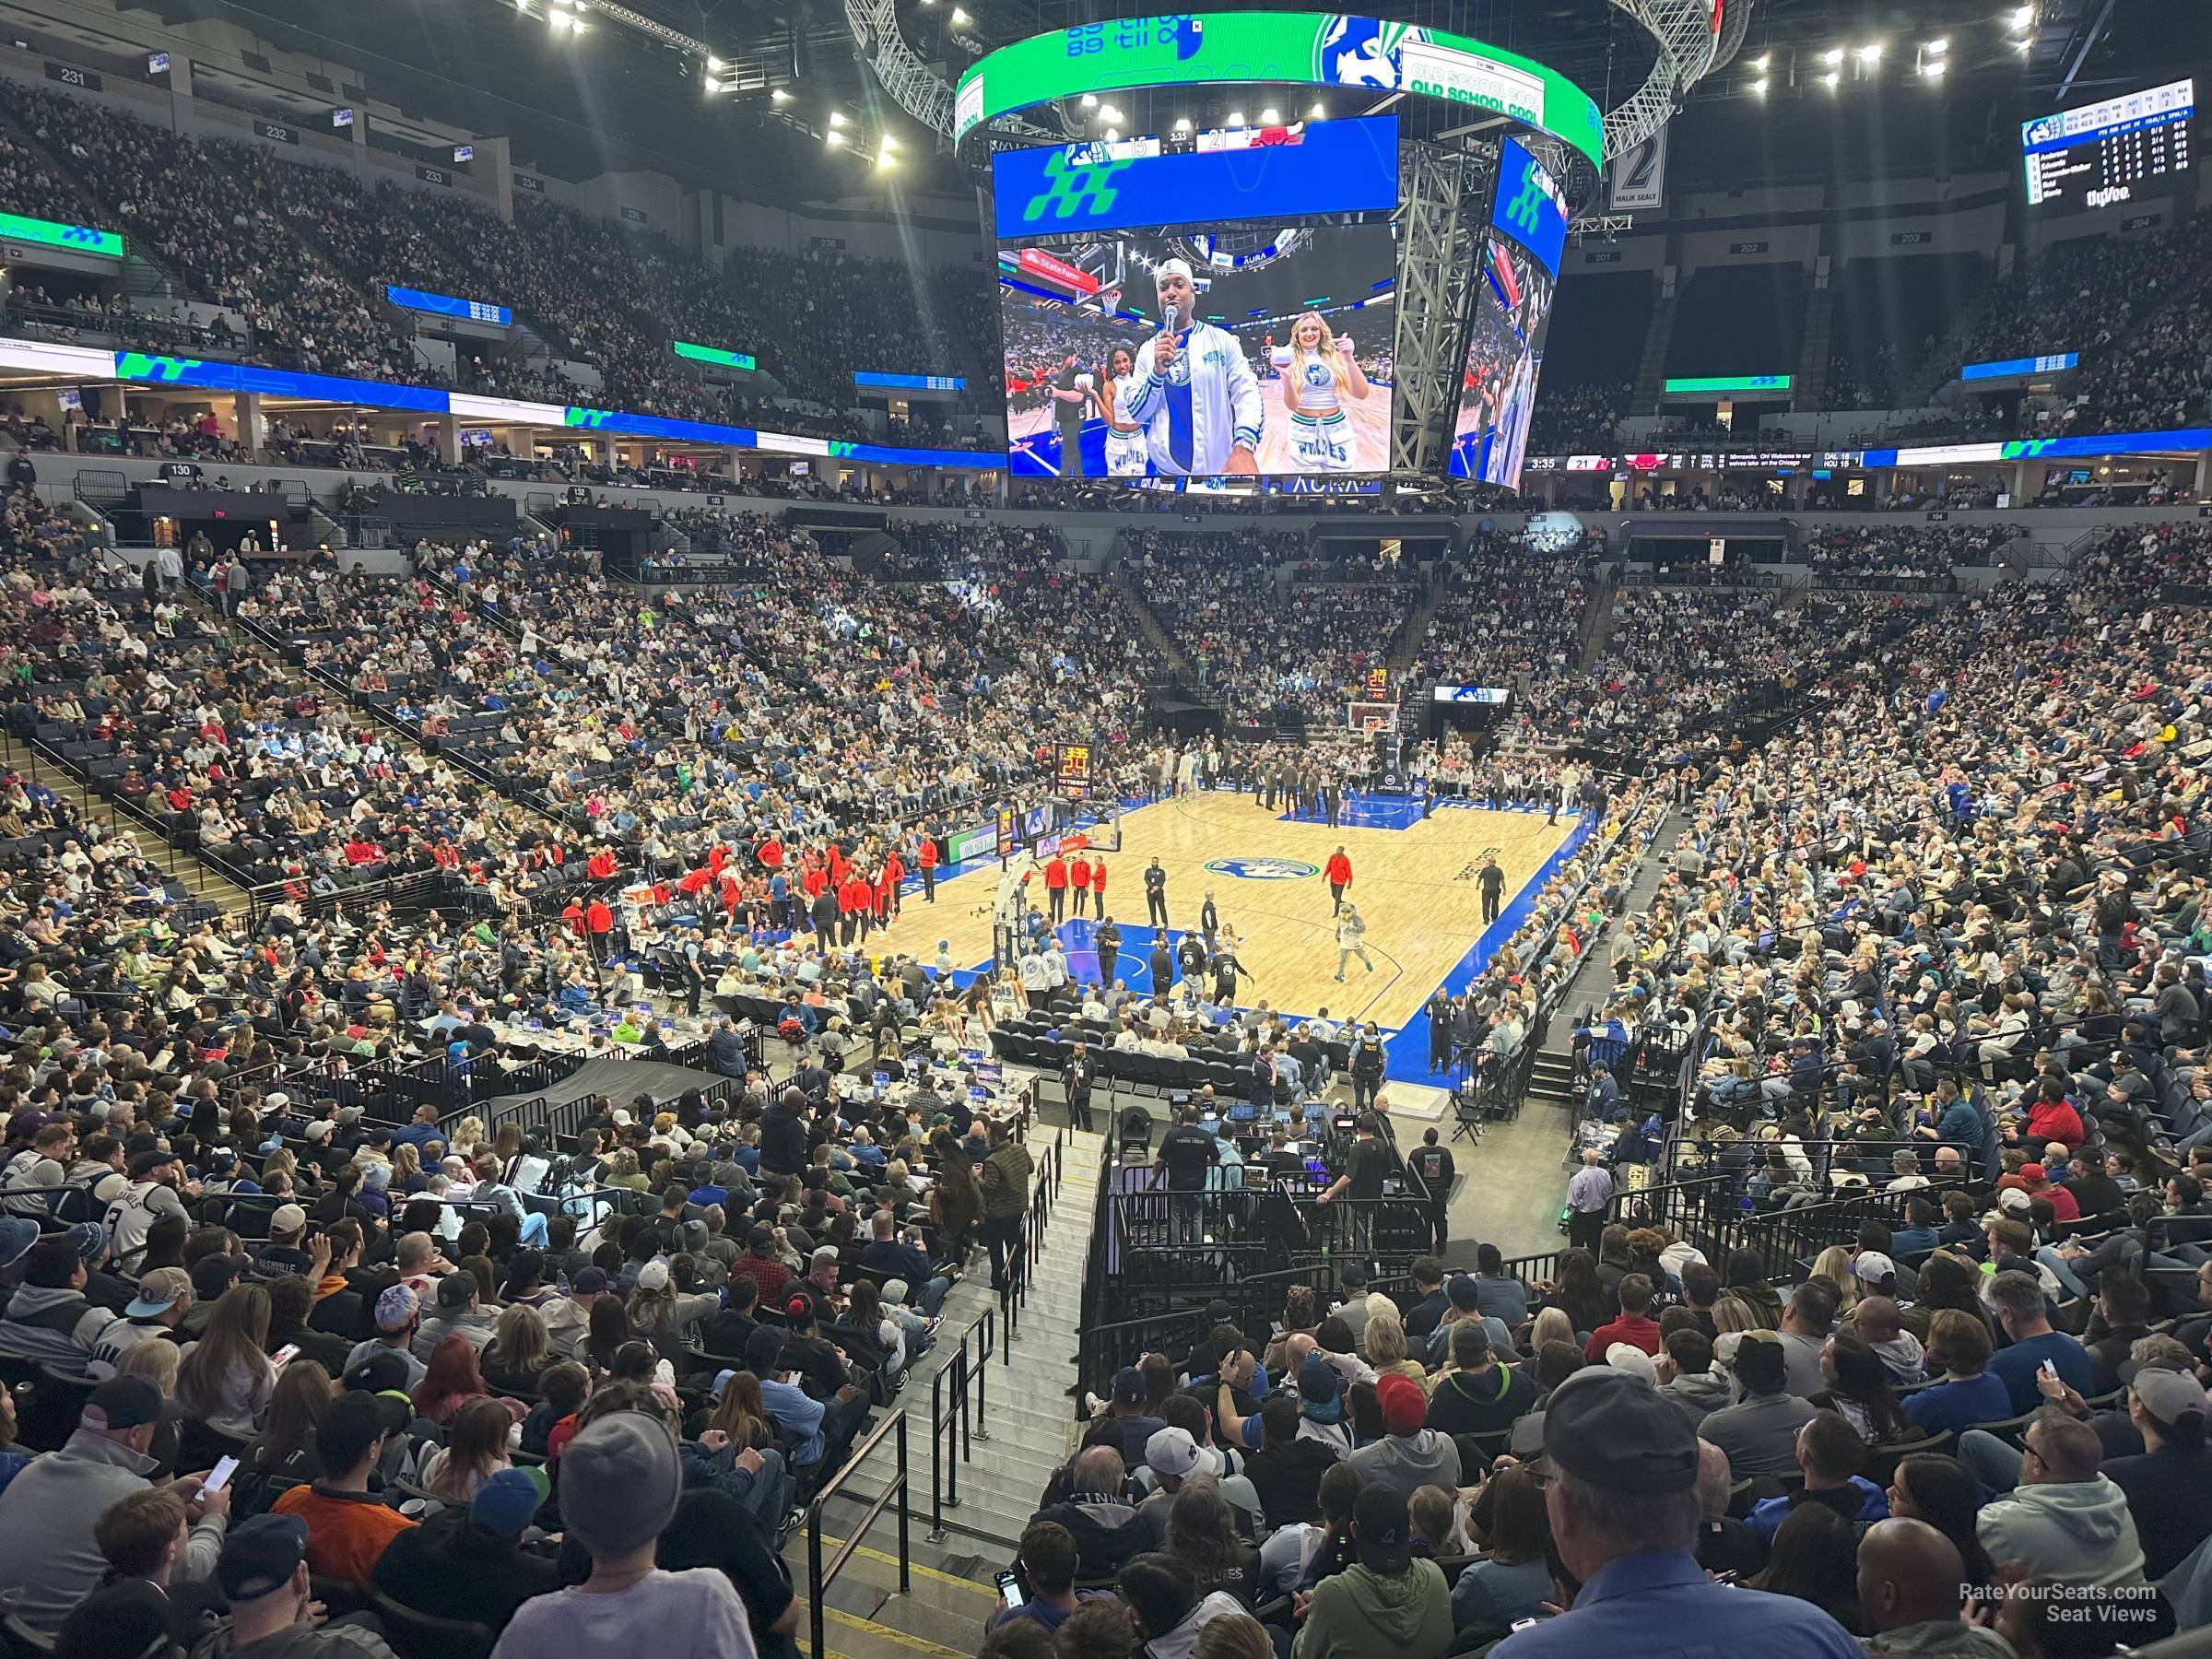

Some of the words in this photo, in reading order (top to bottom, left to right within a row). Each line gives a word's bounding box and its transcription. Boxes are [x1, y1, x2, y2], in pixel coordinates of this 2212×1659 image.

[1067, 37, 1104, 56] 89
[61, 68, 84, 87] 231
[1411, 63, 1445, 82] OLD
[1448, 71, 1506, 97] SCHOOL
[1508, 88, 1539, 109] COOL
[1410, 79, 1444, 97] OLD
[1447, 87, 1506, 112] SCHOOL
[1508, 103, 1537, 124] COOL
[267, 125, 288, 140] 232
[1171, 132, 1187, 142] 3:35
[1209, 129, 1226, 148] 21
[1130, 137, 1147, 156] 15
[1622, 135, 1657, 189] 2
[426, 170, 442, 182] 233
[523, 177, 536, 188] 234
[2132, 218, 2149, 229] 204
[1902, 234, 1921, 243] 203
[1740, 243, 1759, 253] 202
[1595, 253, 1611, 262] 201
[1532, 459, 1556, 468] 3:35
[1576, 460, 1587, 468] 21
[171, 465, 190, 476] 130
[573, 488, 584, 496] 132
[1370, 675, 1384, 687] 24
[1067, 747, 1088, 759] 3:35
[1062, 758, 1086, 778] 24
[723, 879, 728, 890] 9
